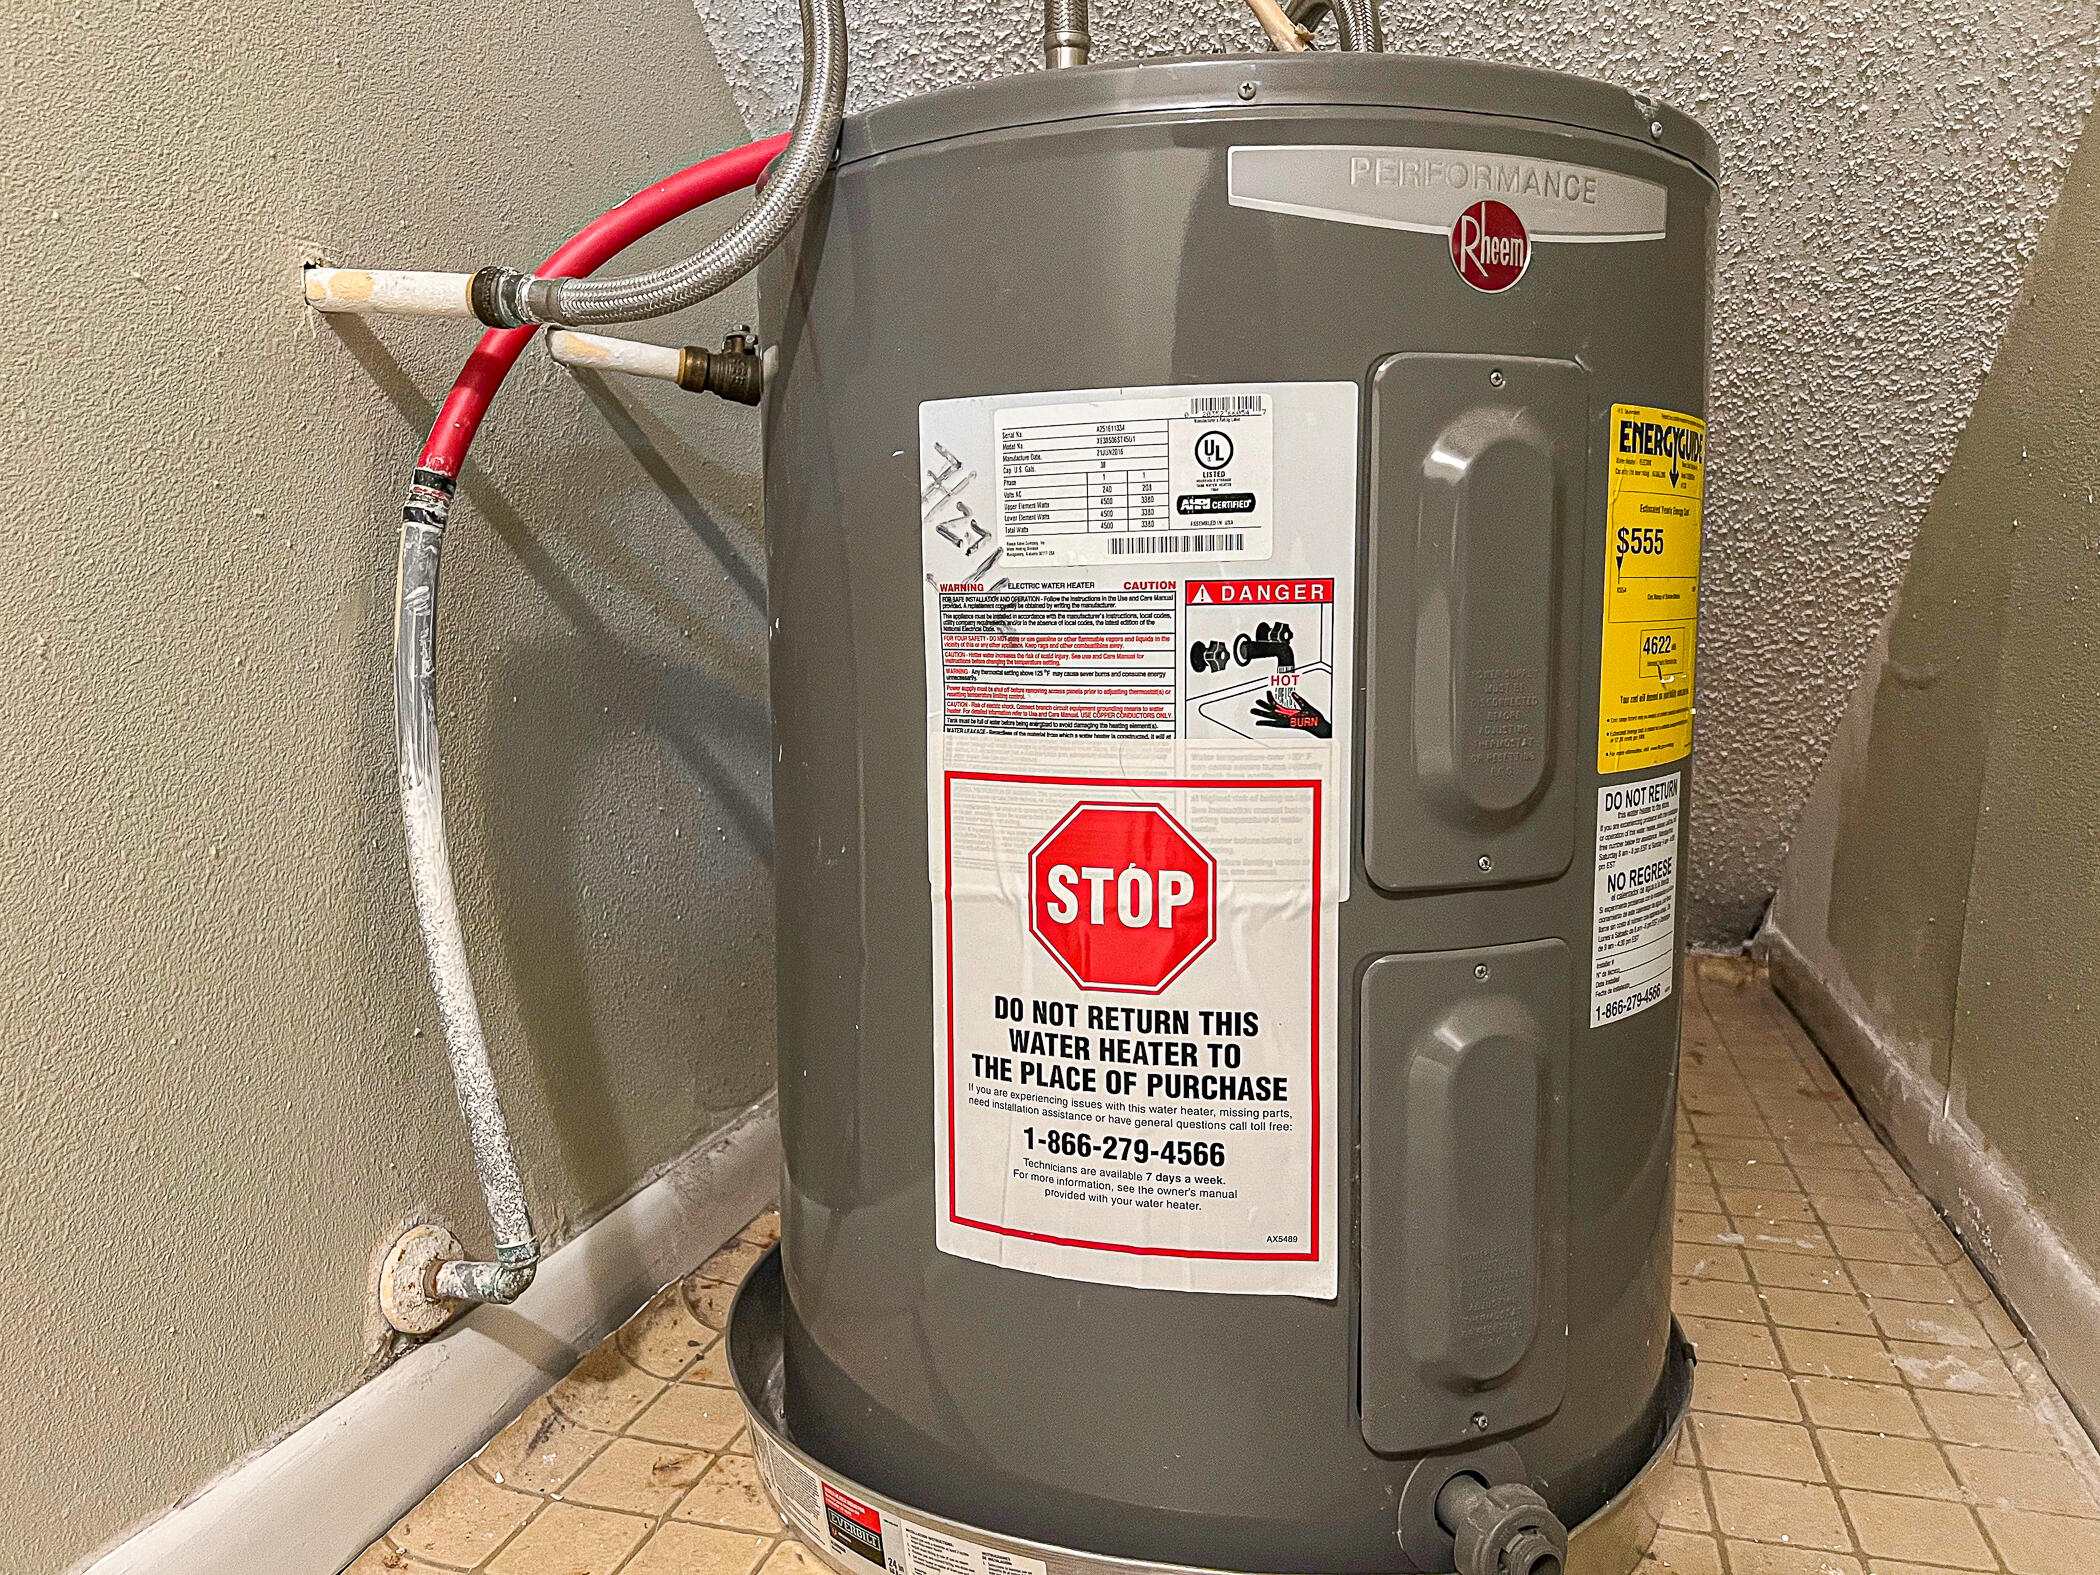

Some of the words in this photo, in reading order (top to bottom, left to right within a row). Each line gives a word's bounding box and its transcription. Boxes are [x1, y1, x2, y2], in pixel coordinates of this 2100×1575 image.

[1350, 156, 1598, 204] PERFORMANCE
[1460, 202, 1523, 277] Rheem
[1002, 432, 1015, 440] Serial
[1619, 420, 1703, 464] ENERGYGUIDE
[1003, 454, 1030, 462] Manufacture
[1204, 439, 1225, 462] UL
[1004, 479, 1017, 487] Phase
[1102, 486, 1112, 494] 240
[1004, 514, 1018, 522] Lower
[1100, 510, 1114, 518] 4500
[1018, 502, 1036, 510] Element
[1100, 522, 1114, 530] 4500
[1616, 526, 1664, 555] $555
[940, 584, 984, 592] WARNING
[1041, 582, 1066, 590] WATER
[1124, 581, 1176, 590] CAUTION
[1222, 584, 1324, 601] DANGER
[1642, 635, 1672, 655] 4622
[1270, 674, 1300, 686] HOT
[1290, 716, 1318, 726] BURN
[1605, 792, 1622, 812] DO
[1626, 787, 1647, 808] NOT
[1648, 778, 1678, 804] RETURN
[1608, 872, 1626, 893] NO
[1629, 856, 1672, 888] REGRESE
[1046, 863, 1195, 929] STOP
[1596, 983, 1661, 1021] 1-866-279-4566
[994, 996, 1024, 1022] DO
[1032, 1000, 1078, 1028] NOT
[1088, 1005, 1189, 1035] RETURN
[1198, 1011, 1259, 1037] THIS
[1008, 1028, 1090, 1061] WATER
[1099, 1037, 1198, 1067] HEATER
[1207, 1043, 1241, 1069] TO
[972, 1053, 1012, 1083] THE
[1020, 1060, 1096, 1093] PLACE
[1106, 1070, 1138, 1096] OF
[1147, 1073, 1288, 1102] PURCHASE
[968, 1082, 974, 1092] If
[976, 1086, 992, 1096] you
[993, 1089, 1008, 1098] are
[1010, 1091, 1068, 1109] experiencing
[1071, 1098, 1102, 1110] issues
[1106, 1102, 1126, 1112] with
[1128, 1104, 1146, 1114] this
[1148, 1106, 1178, 1115] water
[1180, 1106, 1216, 1118] heater,
[1220, 1108, 1260, 1120] missing
[1262, 1109, 1293, 1120] parts,
[968, 1096, 990, 1108] need
[992, 1100, 1040, 1114] installation
[1042, 1108, 1092, 1122] assistance
[1095, 1114, 1105, 1122] or
[1108, 1114, 1132, 1126] have
[1134, 1119, 1174, 1128] general
[1176, 1120, 1226, 1130] questions
[1229, 1122, 1248, 1131] call
[1250, 1122, 1266, 1131] toll
[1269, 1122, 1293, 1132] free:
[1023, 1126, 1225, 1167] 1-866-279-4566
[1013, 1170, 1028, 1180] For
[1030, 1174, 1054, 1184] more
[1056, 1177, 1114, 1192] information,
[1117, 1184, 1135, 1193] see
[1138, 1186, 1154, 1194] the
[1156, 1188, 1196, 1197] owner's
[1199, 1190, 1238, 1198] manual
[1023, 1158, 1078, 1174] Technicians
[1080, 1167, 1096, 1176] are
[1099, 1168, 1143, 1182] available
[1146, 1172, 1152, 1182] 7
[1155, 1172, 1182, 1184] days
[1194, 1176, 1226, 1185] week.
[1044, 1188, 1086, 1200] provided
[1088, 1194, 1108, 1204] with
[1110, 1196, 1133, 1206] your
[1135, 1200, 1164, 1208] water
[1166, 1200, 1202, 1210] heater.
[830, 1511, 880, 1547] EVERBILT
[887, 1557, 898, 1568] 24
